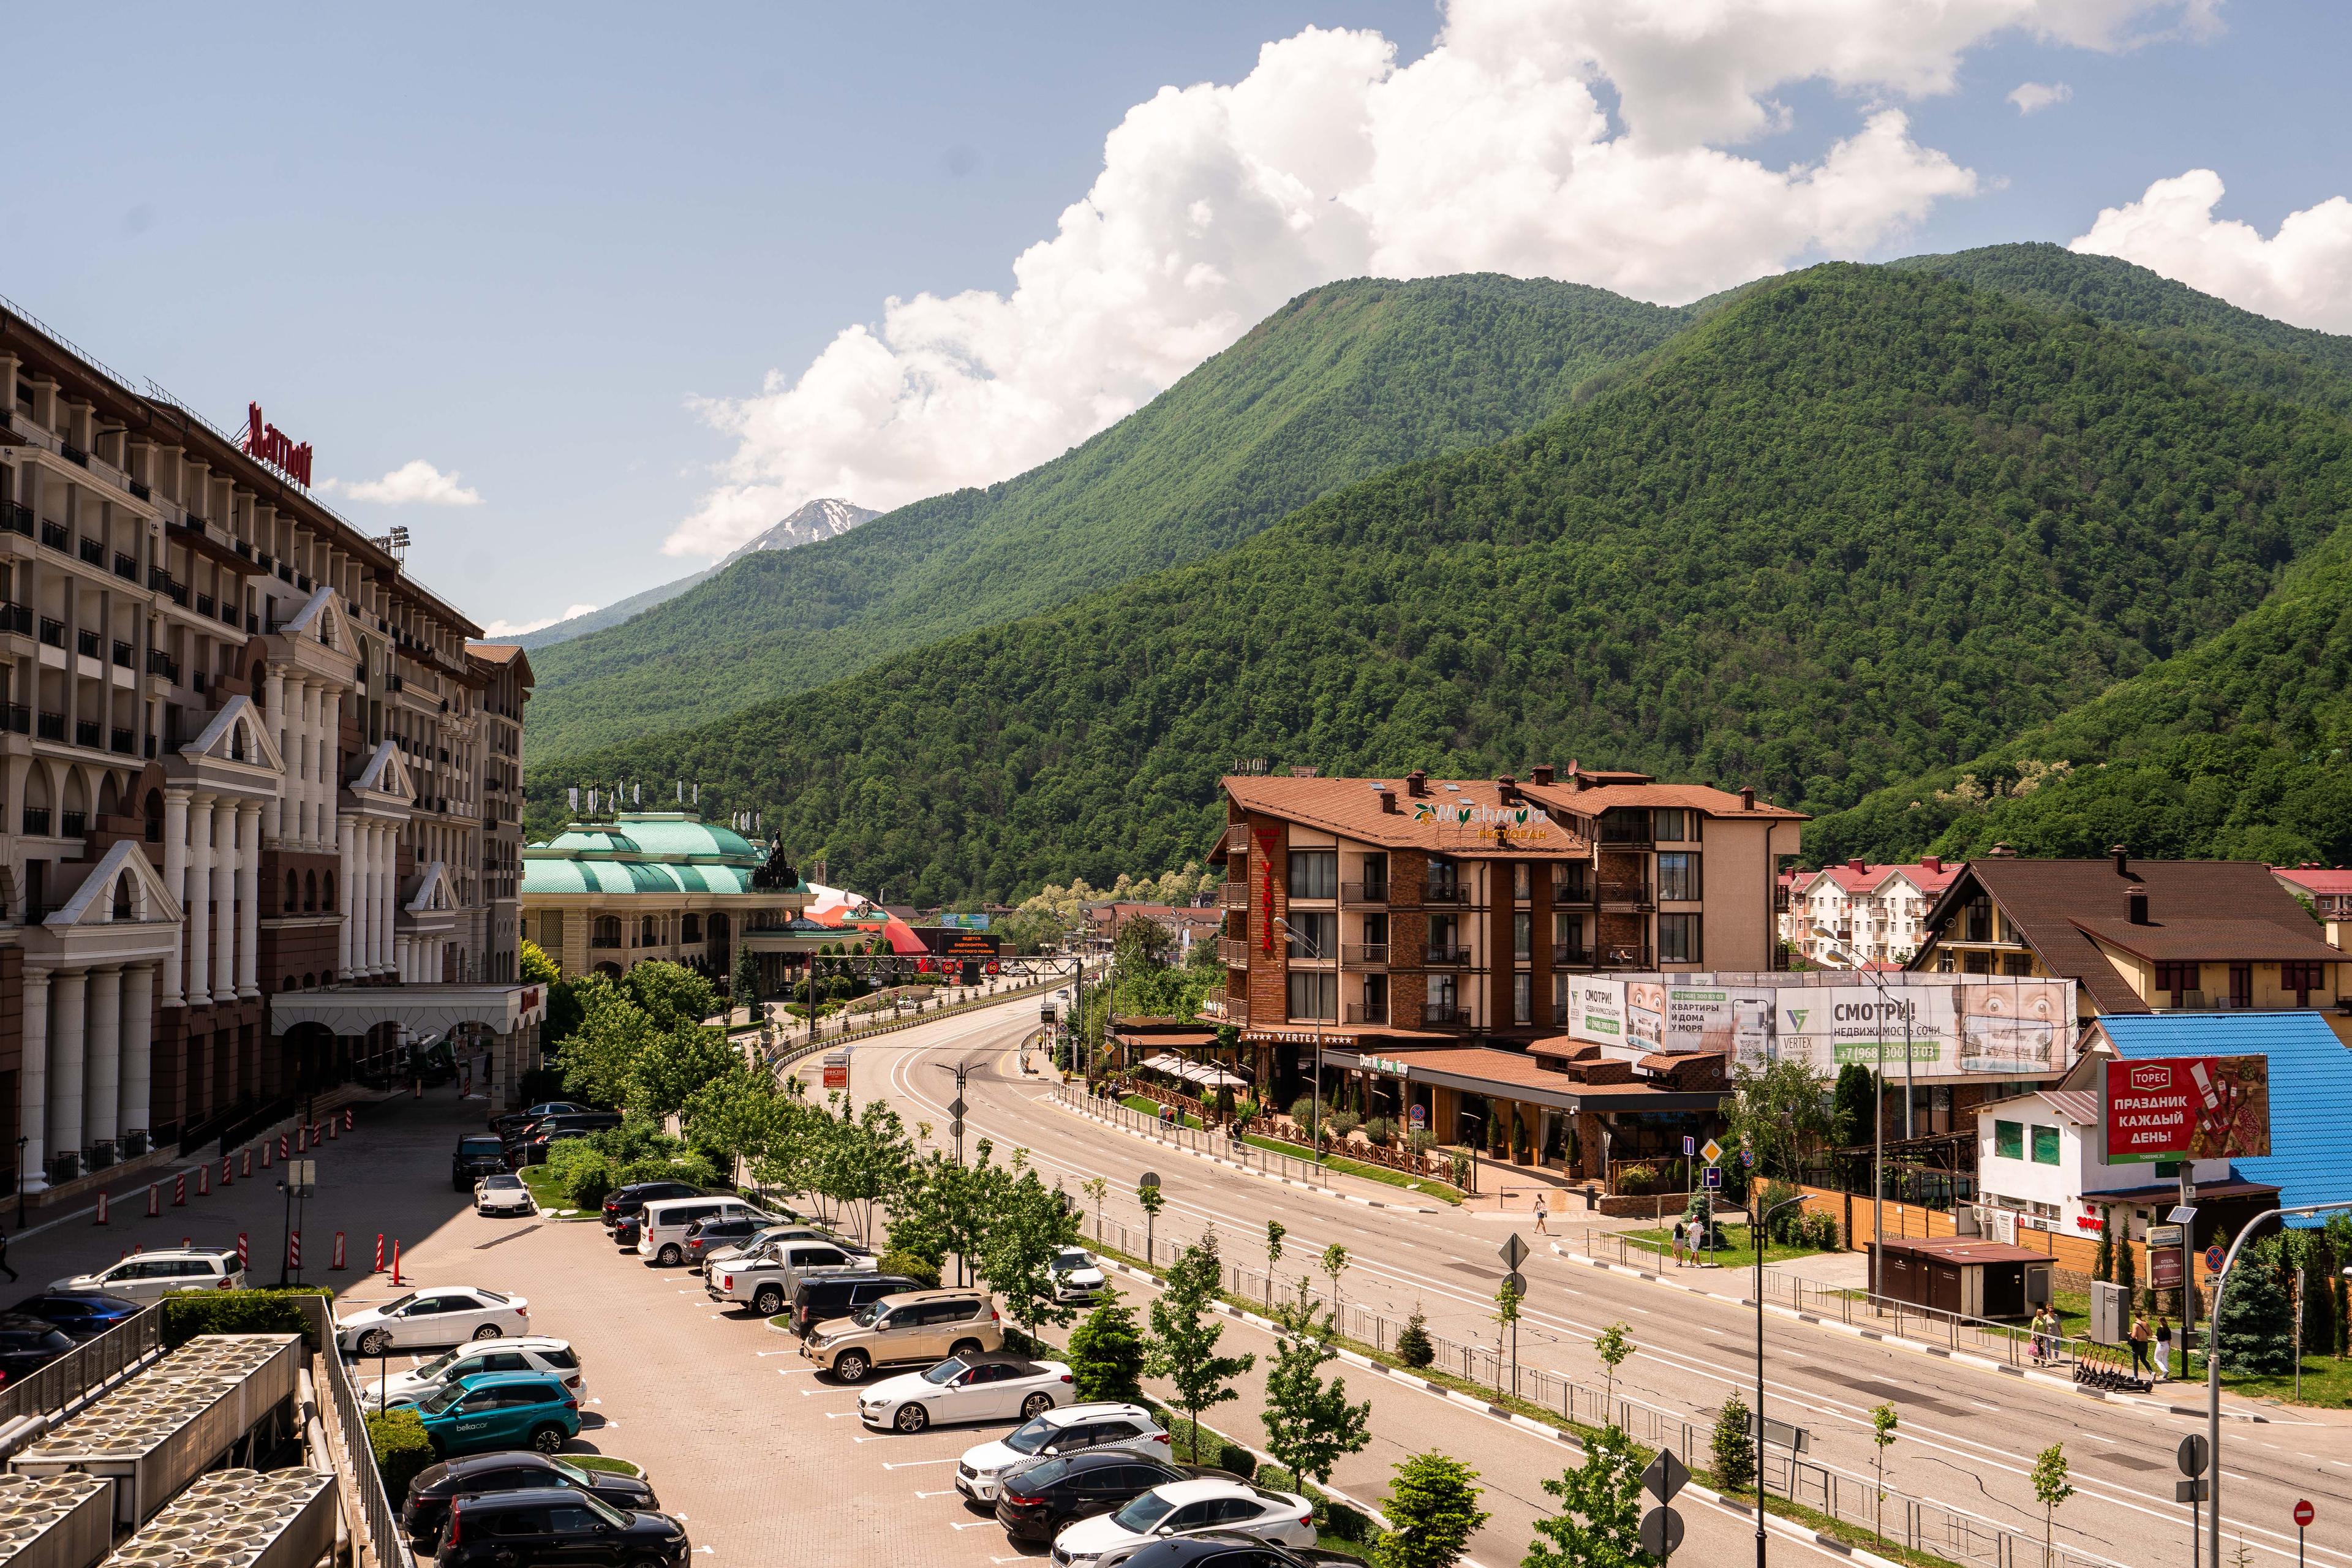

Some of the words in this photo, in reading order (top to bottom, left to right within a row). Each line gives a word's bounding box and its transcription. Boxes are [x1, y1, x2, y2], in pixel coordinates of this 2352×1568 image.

[1478, 829, 1547, 839] РЕСТОРАН
[1262, 861, 1273, 951] VERTEX
[1585, 989, 1611, 1005] СМОТРИ!
[1917, 1026, 1940, 1035] СОЧИ
[1277, 1033, 1317, 1042] VERTEX
[1784, 1037, 1812, 1049] VERTEX
[1840, 1048, 1852, 1058] +7
[1854, 1047, 1879, 1061] (968
[1884, 1047, 1904, 1058] 300
[1921, 1047, 1934, 1057] 03
[1360, 1054, 1372, 1068] Don
[2135, 1073, 2166, 1082] ТОРЕС
[2114, 1096, 2188, 1110] ПРАЗДНИК
[2119, 1111, 2184, 1127] КАЖДЫЙ
[2131, 1131, 2171, 1144] ДЕНЬ!
[456, 1422, 488, 1431] belkacar
